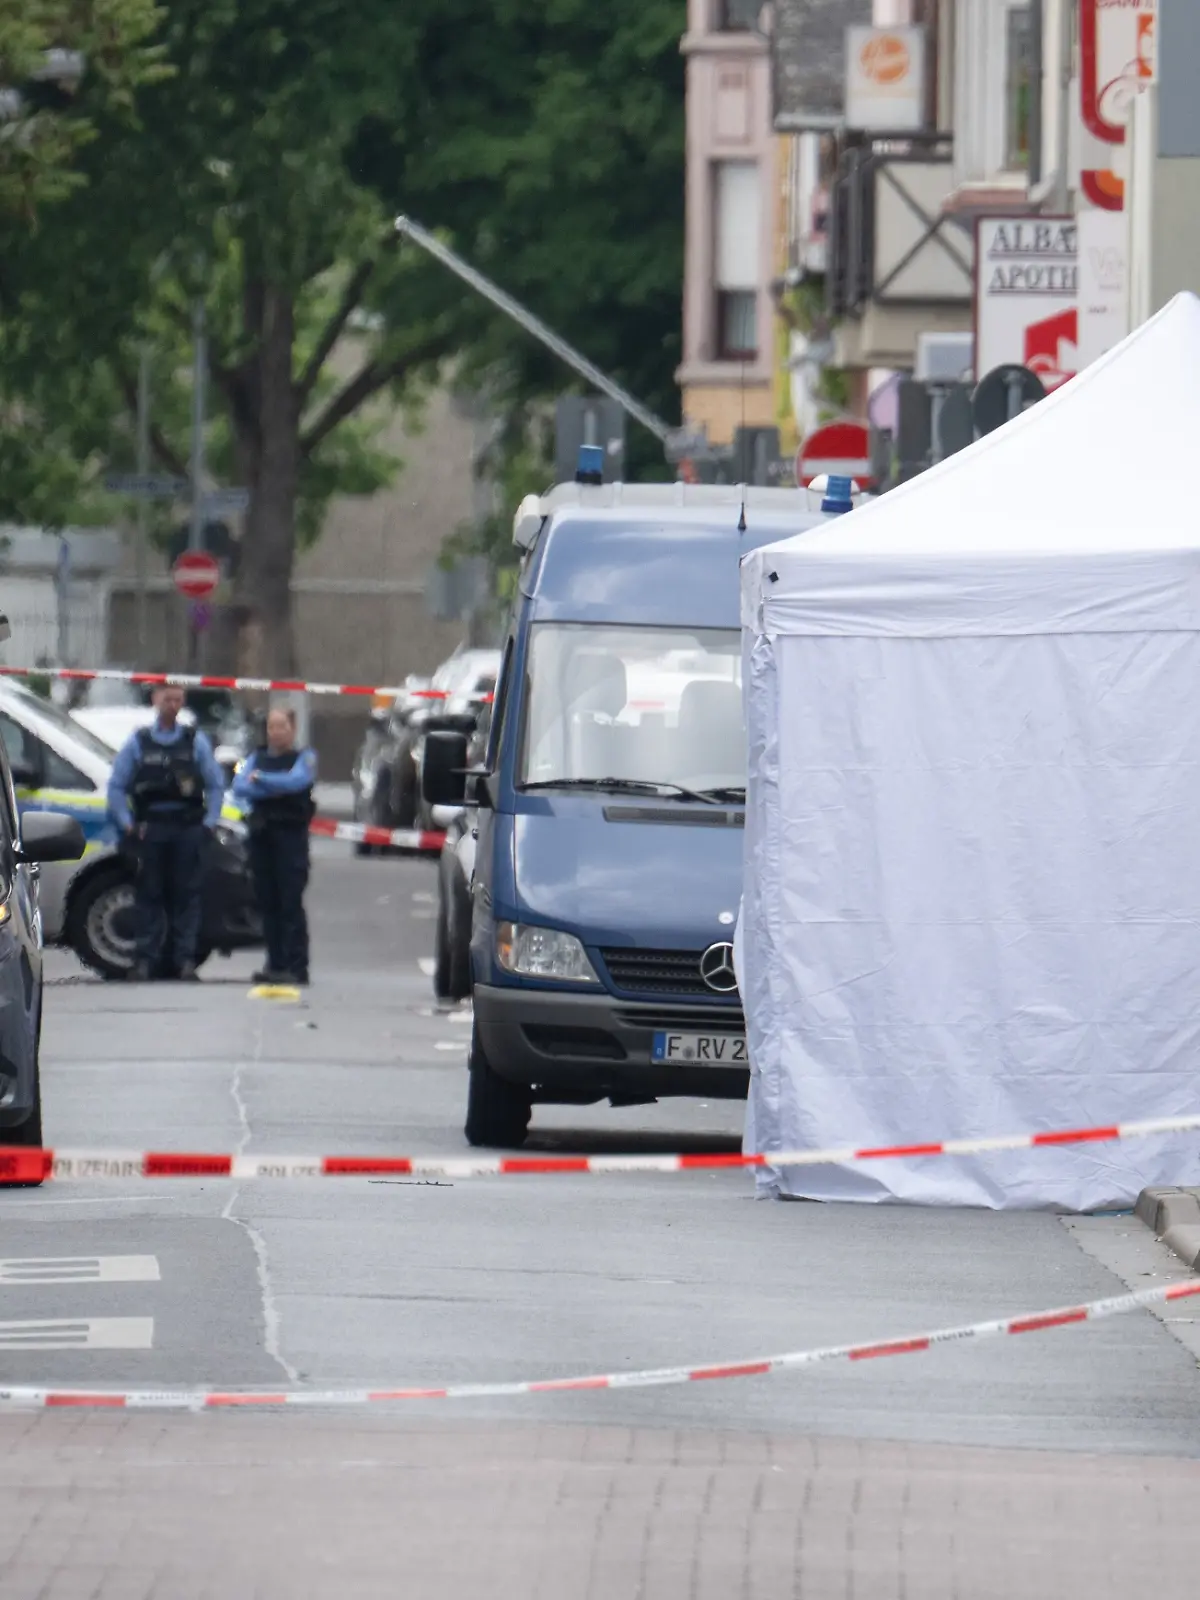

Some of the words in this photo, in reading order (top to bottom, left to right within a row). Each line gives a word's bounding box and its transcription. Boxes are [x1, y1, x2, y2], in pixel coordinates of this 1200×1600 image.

[667, 1036, 682, 1057] F
[697, 1038, 727, 1059] RV
[732, 1039, 748, 1061] 2
